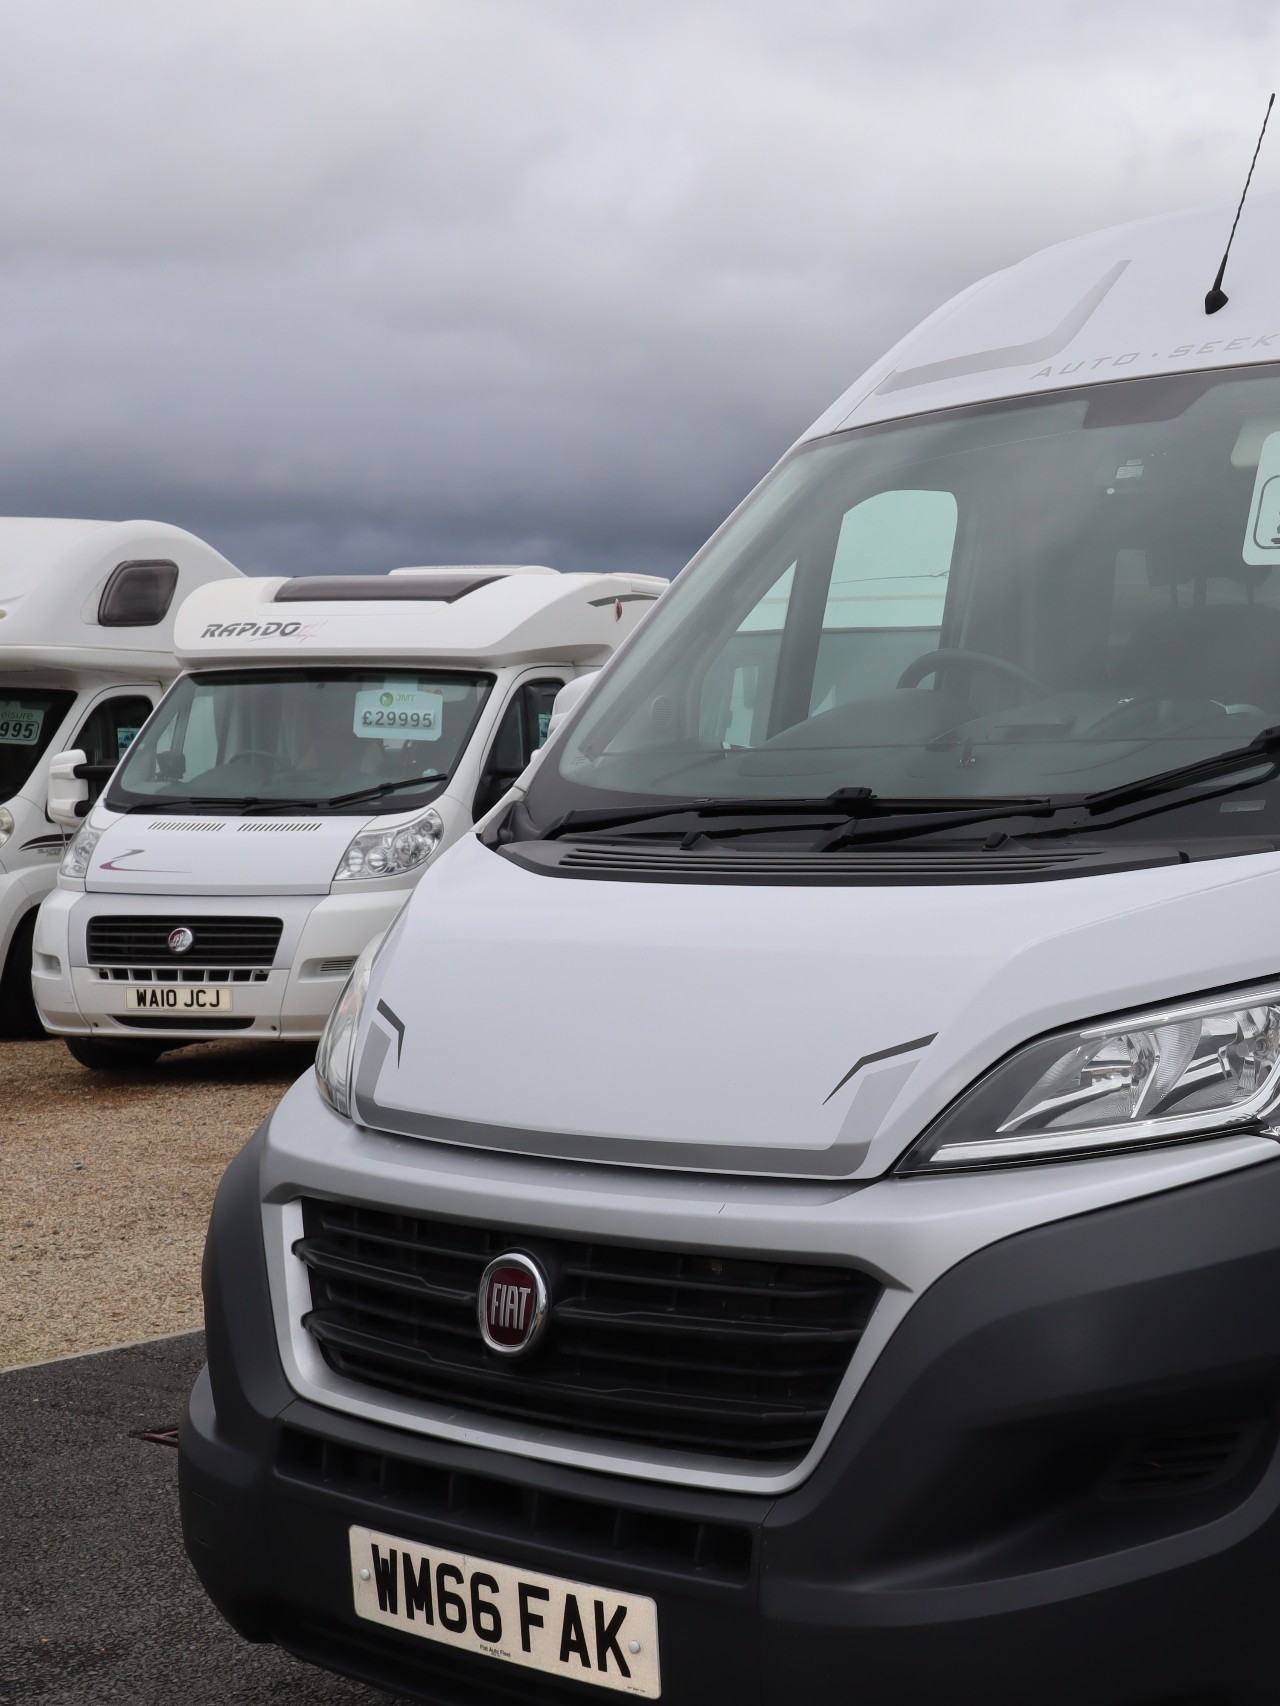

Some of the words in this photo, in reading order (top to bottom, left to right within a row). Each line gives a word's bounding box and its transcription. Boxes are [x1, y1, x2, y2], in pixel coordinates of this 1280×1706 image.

[1028, 352, 1142, 381] AUTO
[200, 622, 302, 638] RAPIDO
[361, 710, 432, 728] £29995
[136, 989, 177, 1007] WA10
[183, 989, 220, 1008] JCJ
[490, 1282, 531, 1330] FIAT
[371, 1543, 503, 1643] WM66
[518, 1582, 631, 1678] FAK
